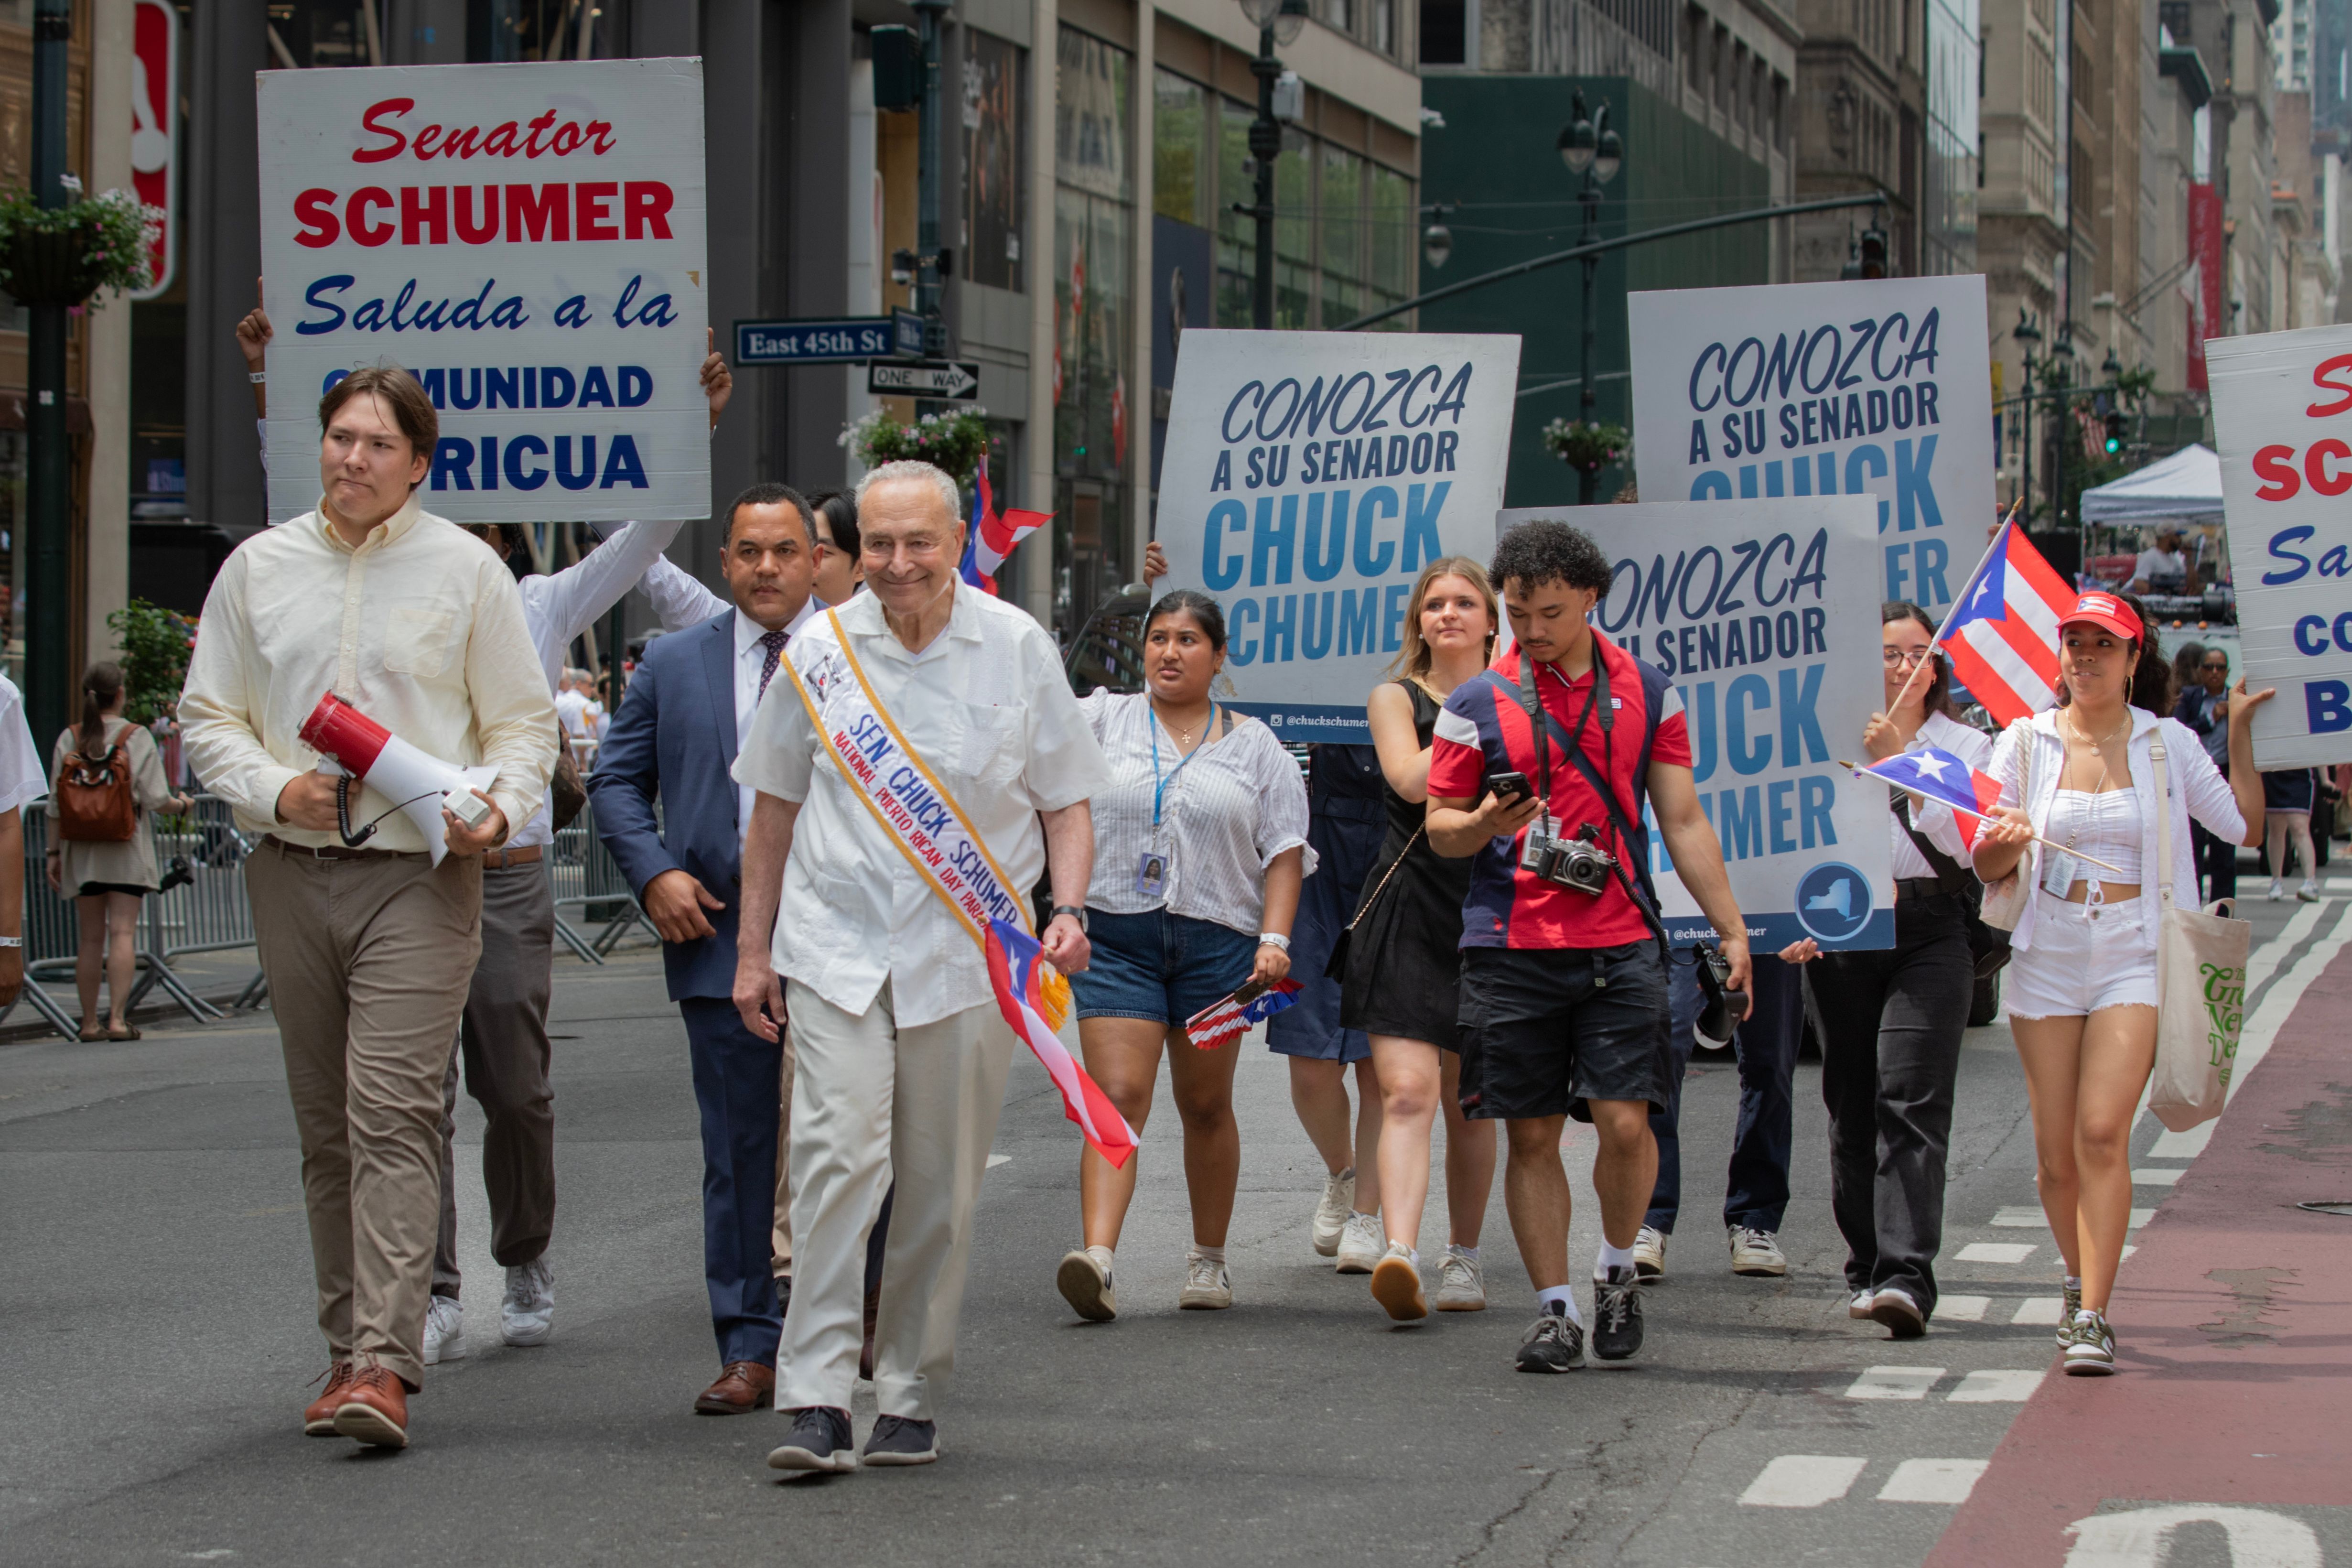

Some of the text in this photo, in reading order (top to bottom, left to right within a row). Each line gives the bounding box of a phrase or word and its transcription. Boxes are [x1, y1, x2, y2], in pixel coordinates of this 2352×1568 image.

[352, 98, 616, 163] Senator
[293, 181, 674, 248] SCHUMER
[295, 274, 678, 335] Saluda a la
[749, 334, 798, 355] East
[804, 332, 853, 353] 45th
[860, 330, 885, 351] St
[322, 366, 653, 410] MUNIDAD
[878, 369, 966, 388] ONE WAY
[1689, 306, 1940, 412] CONOZCA
[1221, 361, 1473, 443] CONOZCA
[1689, 381, 1940, 465] A SU SENADOR
[430, 434, 649, 491] RICUA
[1210, 430, 1459, 492] A SU SENADOR
[1202, 480, 1453, 592] CHUCK
[1586, 527, 1828, 633] ONOZCA
[1215, 584, 1416, 667] CHUME
[1656, 607, 1827, 678] SENADOR
[1676, 663, 1831, 784] UCK
[833, 730, 876, 789] NATIONAL
[874, 787, 913, 831] PUERTO
[909, 830, 944, 867] RICAN
[939, 867, 965, 892] DAY
[889, 767, 952, 839] CHUCK
[949, 840, 1017, 924] SCHUMER
